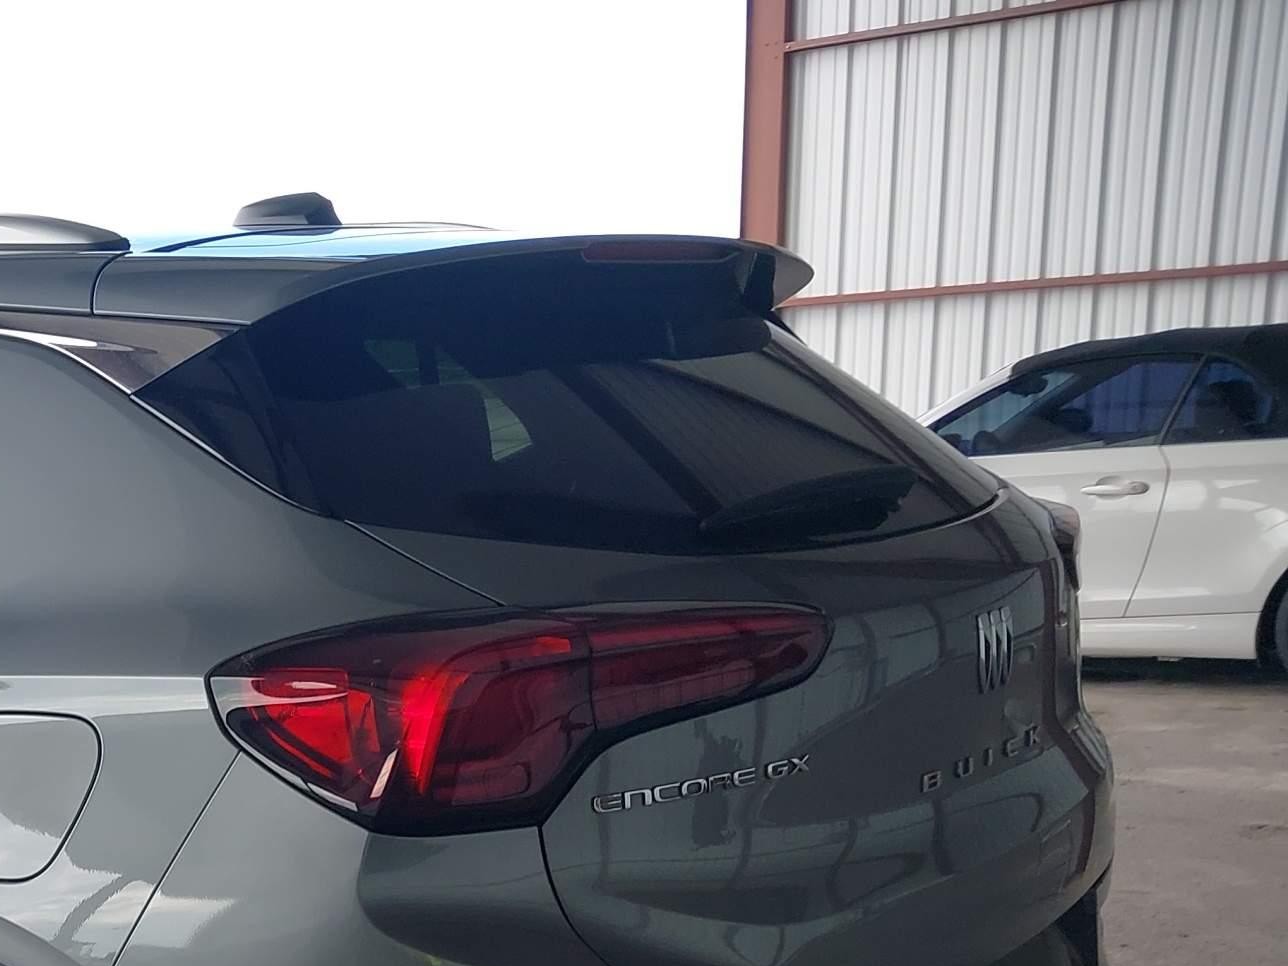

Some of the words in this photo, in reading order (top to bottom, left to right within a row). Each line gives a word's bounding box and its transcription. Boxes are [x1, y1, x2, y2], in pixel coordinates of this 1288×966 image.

[593, 768, 756, 813] ENCORE
[766, 754, 810, 780] GX
[921, 723, 1040, 792] BUICK
